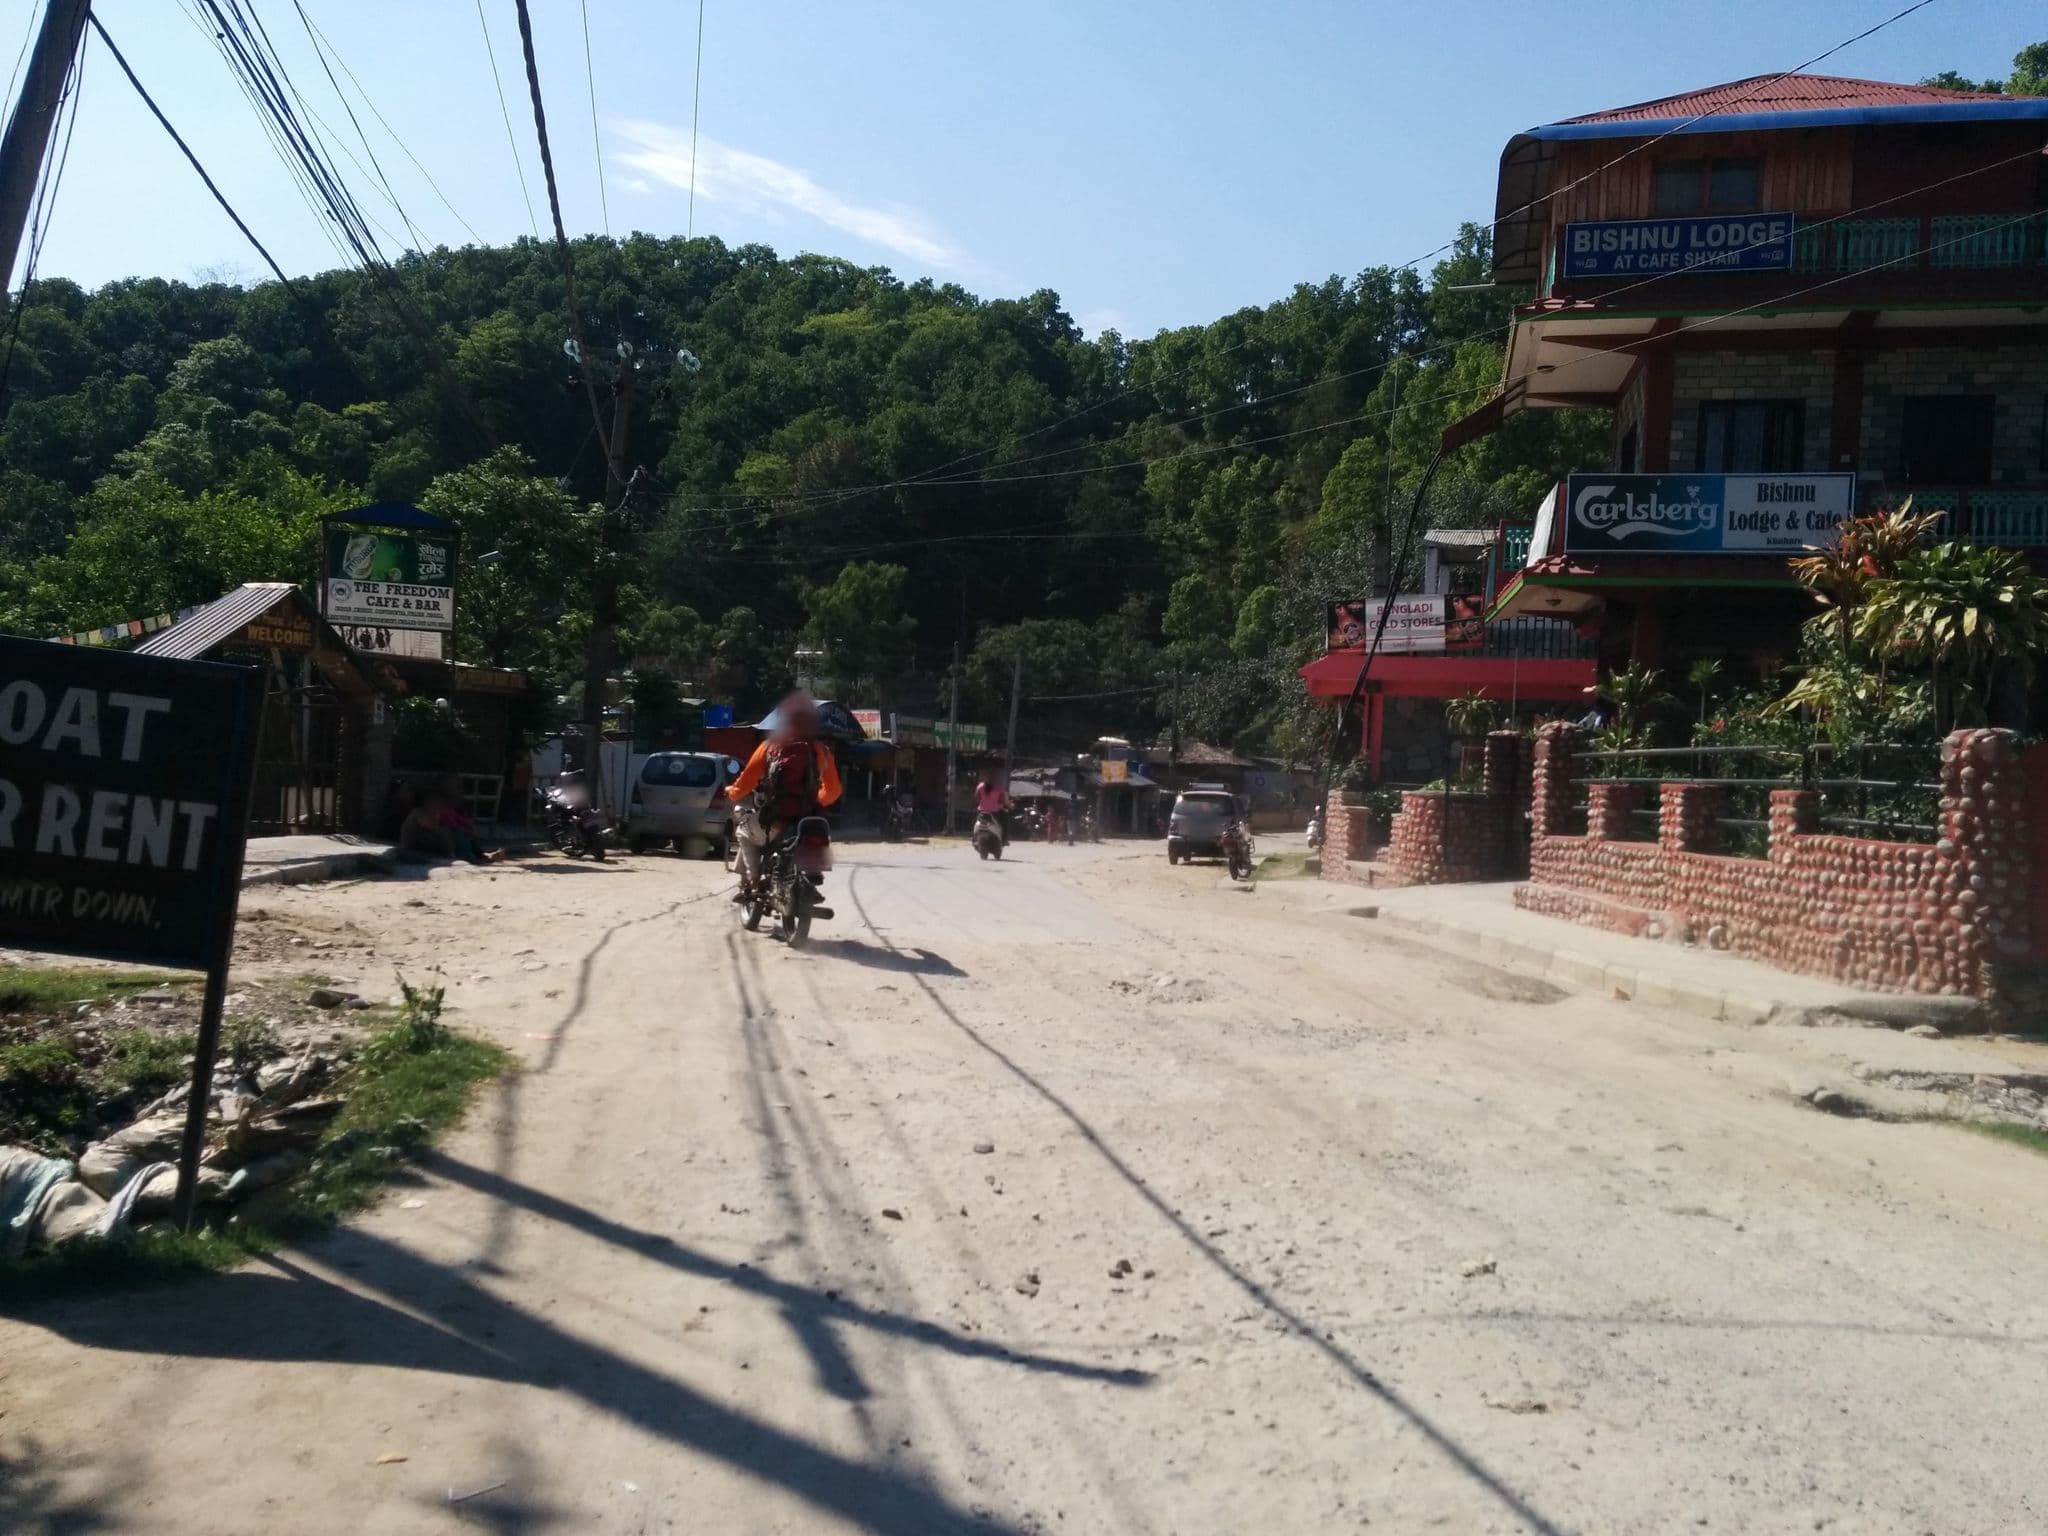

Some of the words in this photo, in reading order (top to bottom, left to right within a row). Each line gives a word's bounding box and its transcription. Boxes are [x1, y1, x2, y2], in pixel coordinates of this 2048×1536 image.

[1573, 224, 1680, 252] BISHNU
[1690, 220, 1785, 248] LODGE
[1613, 255, 1633, 270] AT
[1638, 252, 1680, 268] CAFE
[1684, 250, 1741, 267] SHYAM
[1756, 482, 1816, 503] Bishnu
[1574, 485, 1718, 531] Carlsberg
[1728, 509, 1780, 533] Lodge
[1785, 510, 1801, 530] &
[1805, 509, 1843, 531] Cafe
[354, 582, 379, 593] THE
[386, 584, 450, 600] FREEDOM
[366, 596, 400, 609] CAFE
[402, 598, 412, 609] &
[415, 600, 441, 612] BAR
[1376, 603, 1433, 615] BNGLADI
[1400, 617, 1441, 628] STORES
[247, 624, 312, 647] WELCOME
[0, 680, 171, 762] OAT
[35, 783, 219, 871] RENT
